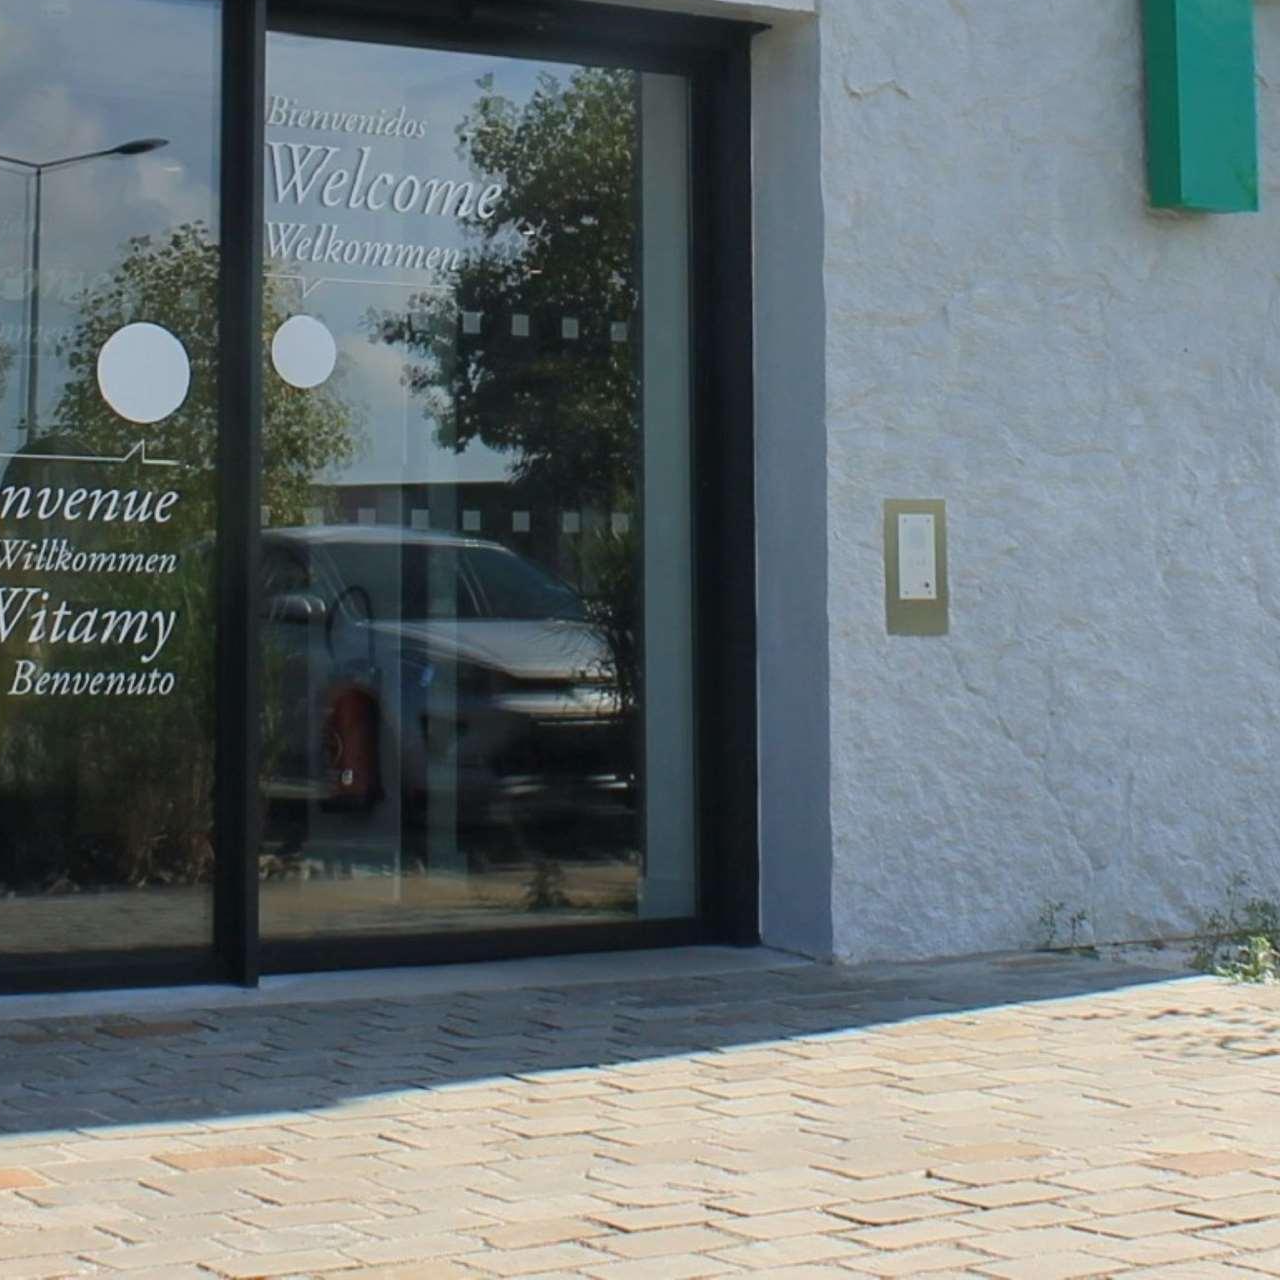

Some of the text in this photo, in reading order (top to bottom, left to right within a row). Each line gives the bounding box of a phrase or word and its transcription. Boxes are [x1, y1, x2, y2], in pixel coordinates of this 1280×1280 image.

[267, 94, 428, 139] Bienvenidos
[265, 139, 503, 219] Welcome
[265, 221, 462, 271] Welkommen
[8, 659, 176, 696] Benvenuto
